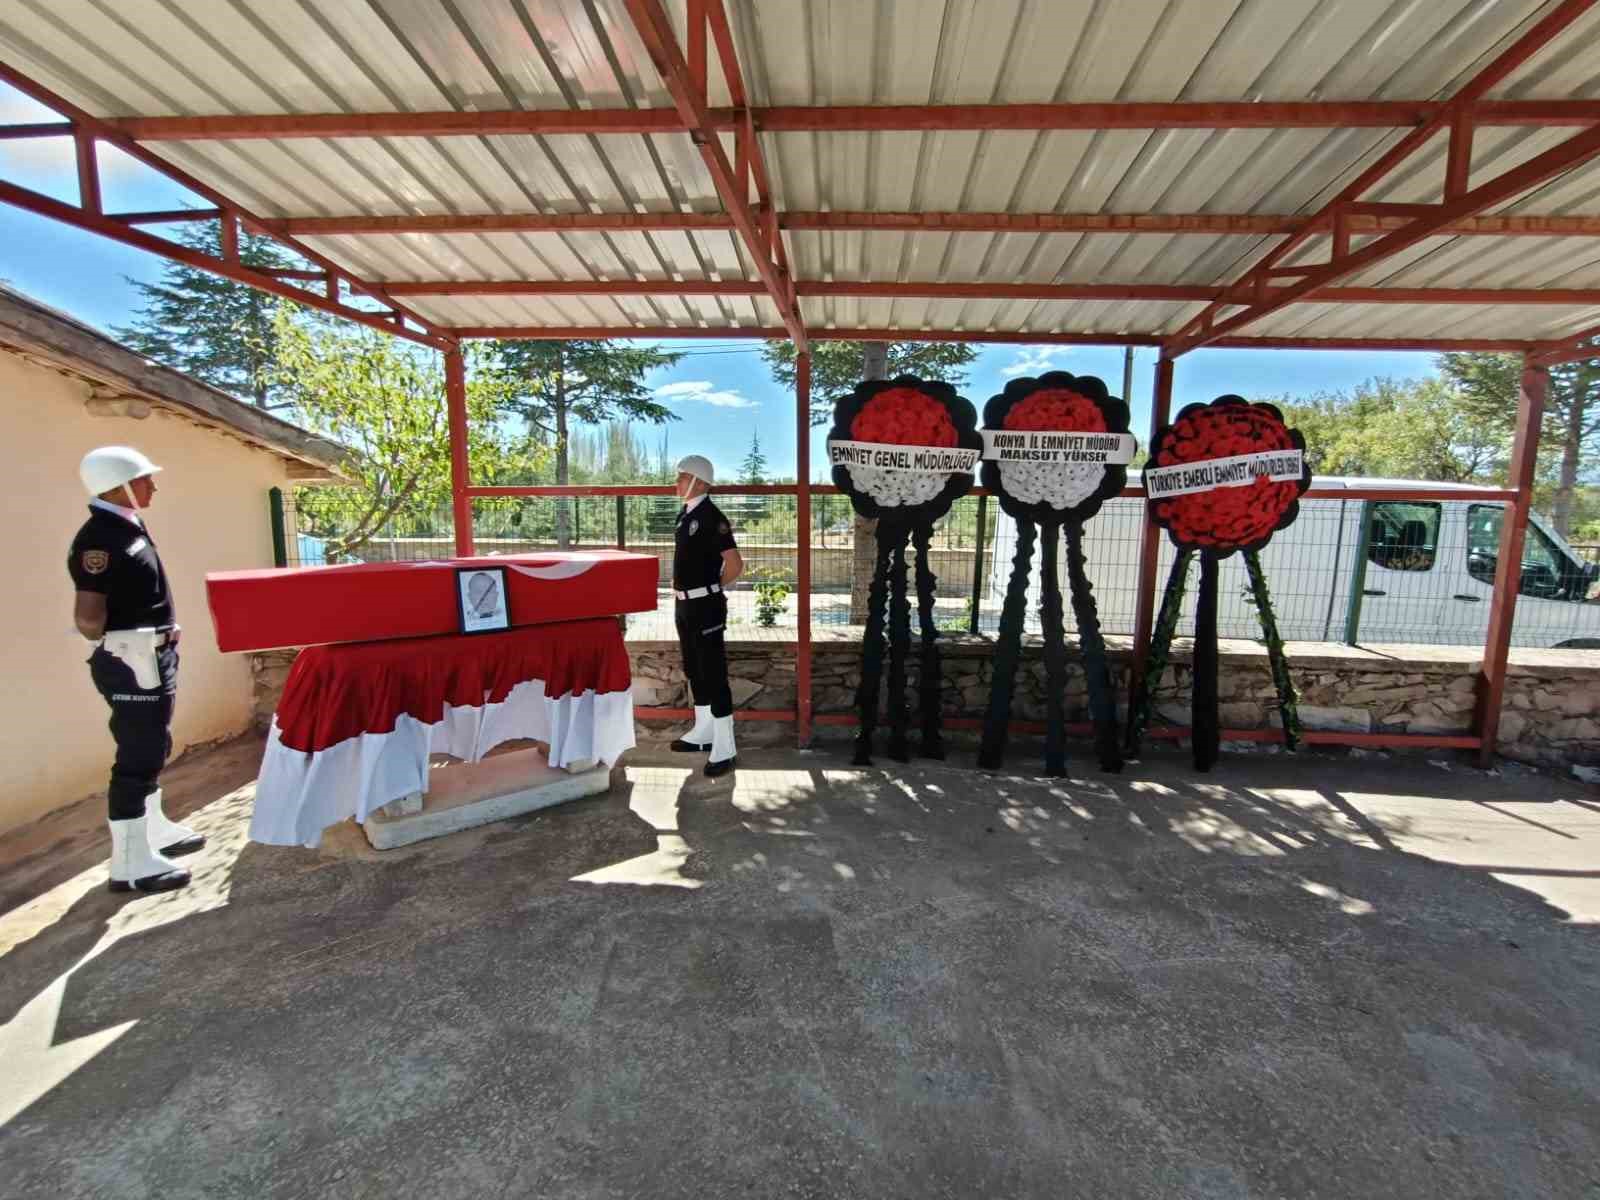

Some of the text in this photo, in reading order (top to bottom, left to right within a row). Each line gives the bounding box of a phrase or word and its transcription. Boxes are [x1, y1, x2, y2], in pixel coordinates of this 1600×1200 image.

[993, 433, 1120, 451] KONYA İL EMNİYET MÜDÜRÜ
[831, 444, 975, 471] EMNİYET GENEL MÜDÜRLÜĞÜ
[1000, 449, 1108, 462] MAKSUT YÜKSEK
[1149, 468, 1182, 492] TÜRKİYE
[1183, 463, 1213, 488] EMEKLİ
[1215, 459, 1247, 483] EMNİYET
